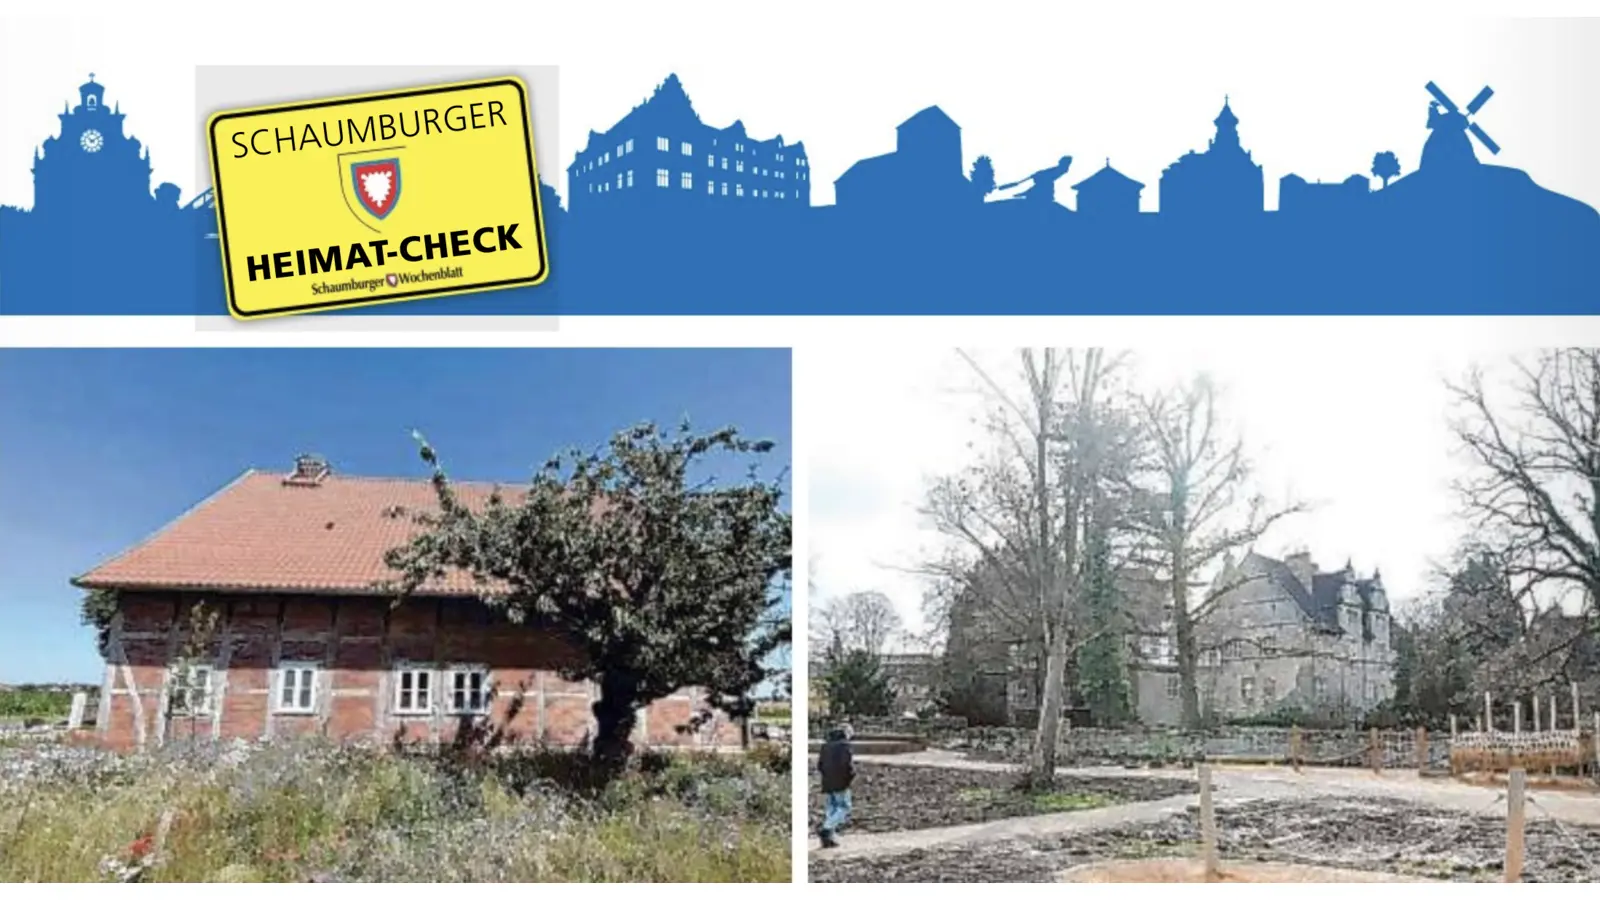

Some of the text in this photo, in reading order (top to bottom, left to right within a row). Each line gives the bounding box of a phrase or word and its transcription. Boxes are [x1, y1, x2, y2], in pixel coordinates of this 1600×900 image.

[231, 100, 507, 158] SCHAUMBURGER
[246, 223, 523, 282] HEIMAT-CHECK
[311, 267, 464, 296] Schaumburger Wochenblatt
